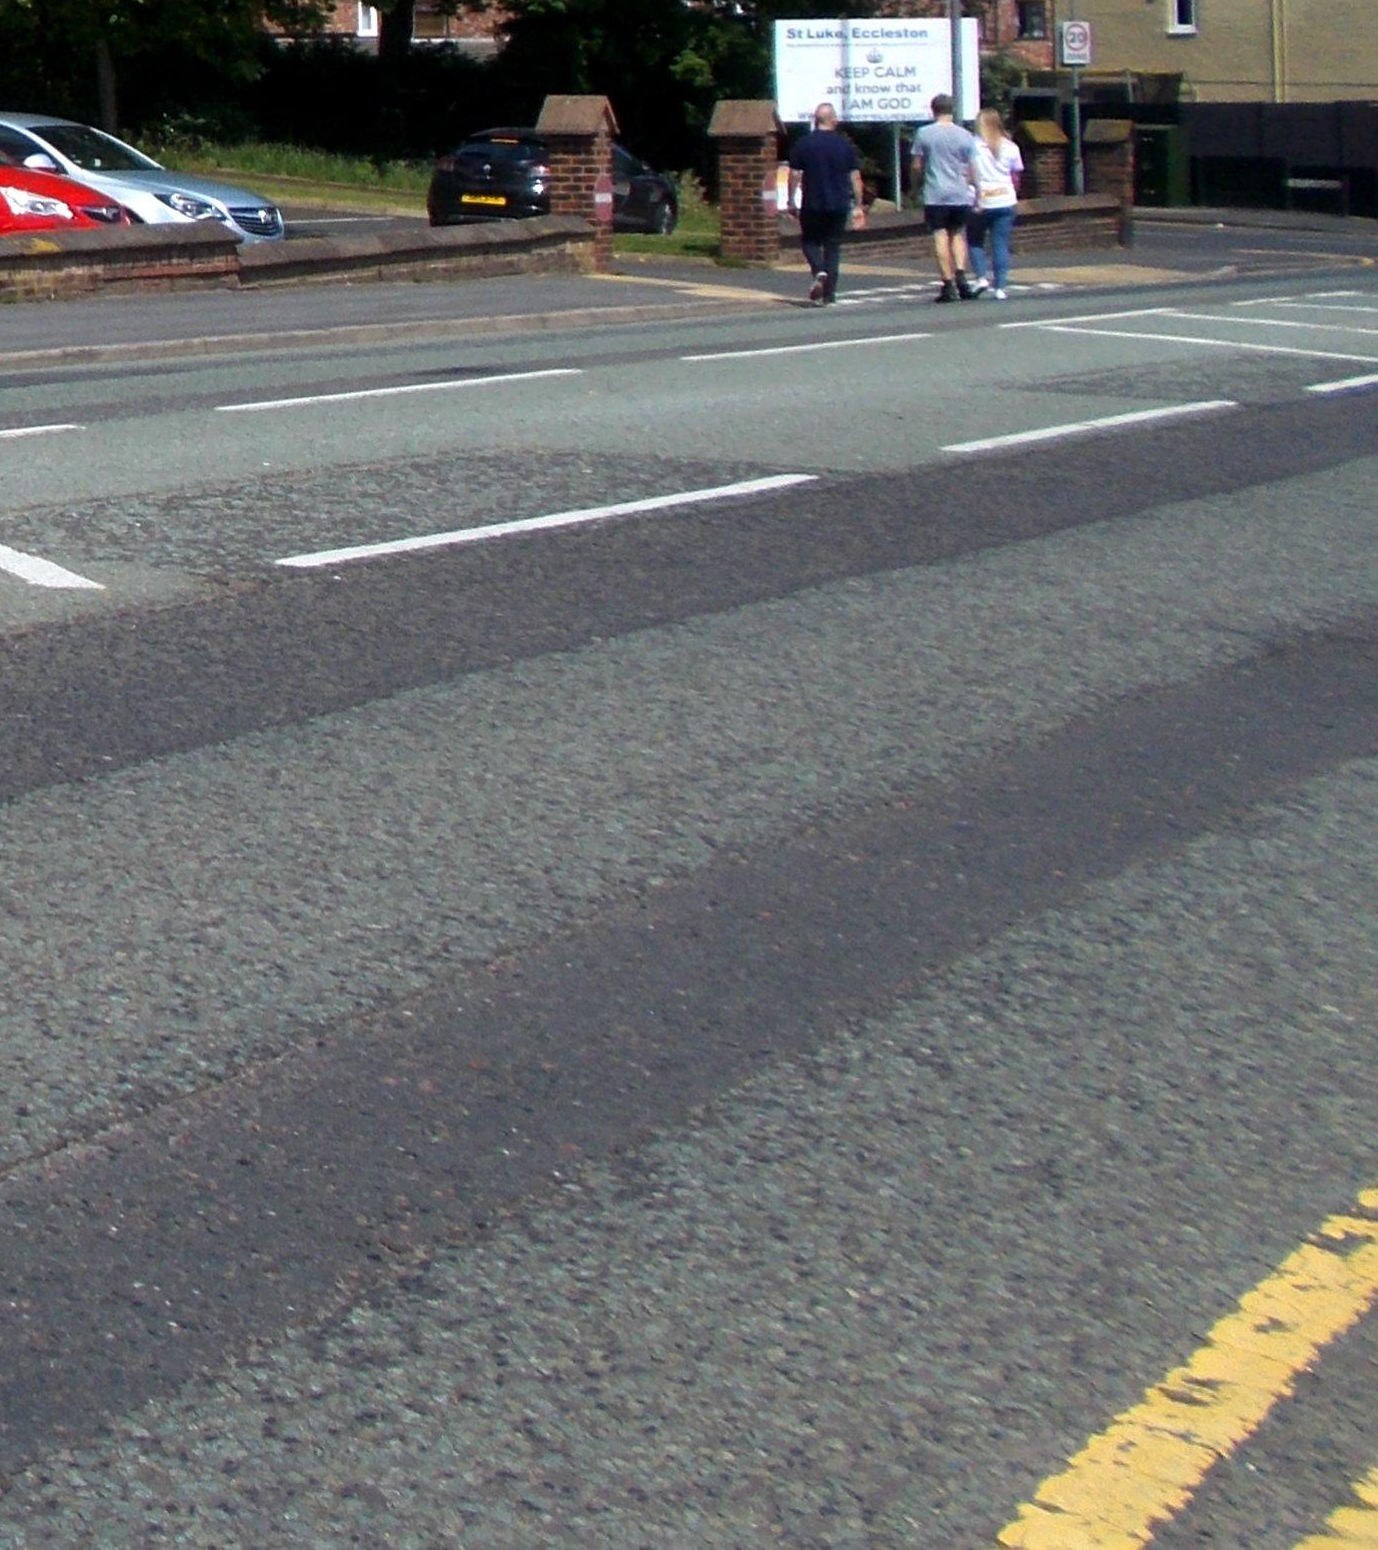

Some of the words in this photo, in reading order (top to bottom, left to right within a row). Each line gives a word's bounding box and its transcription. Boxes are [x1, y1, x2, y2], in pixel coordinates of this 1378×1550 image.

[786, 27, 803, 39] St
[851, 27, 928, 39] Eccleston
[834, 66, 870, 79] KEEP
[874, 66, 917, 78] CALM
[825, 82, 850, 95] and
[854, 82, 891, 94] know
[895, 81, 922, 93] that
[850, 98, 874, 110] AM
[877, 97, 912, 110] GOD
